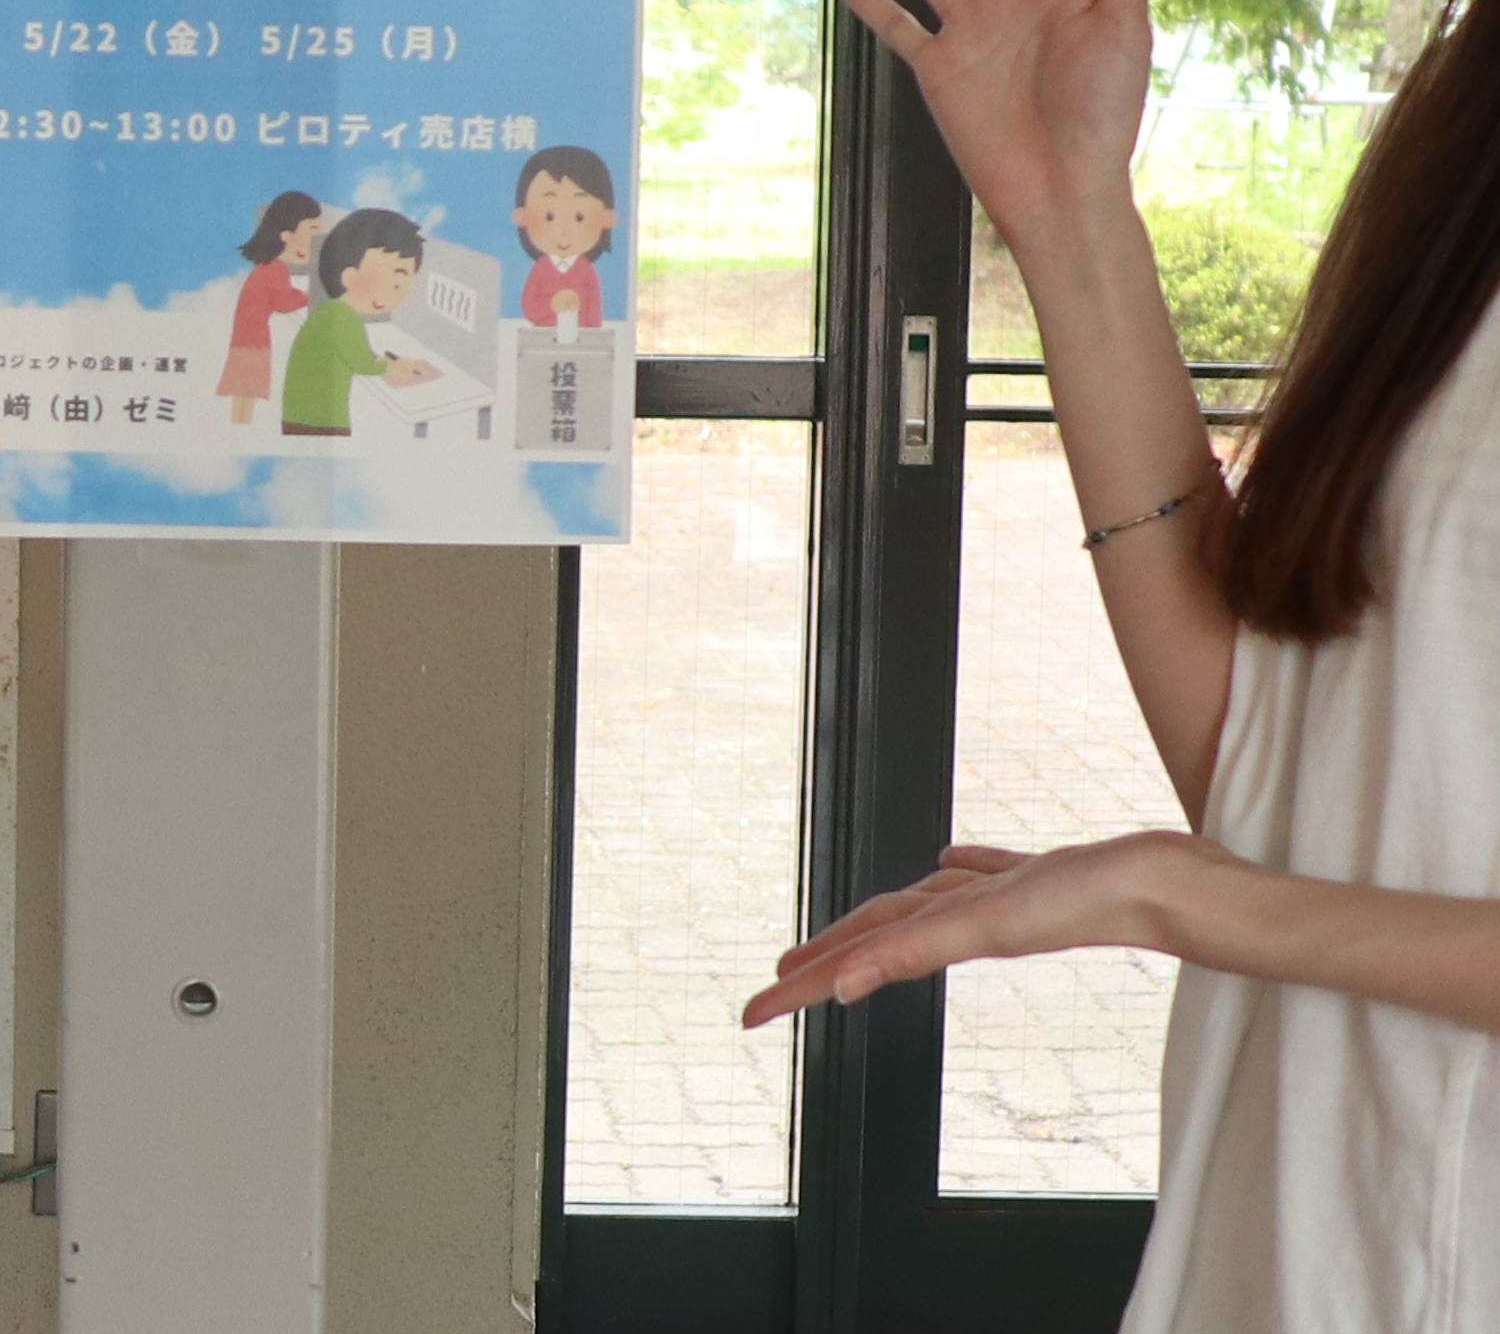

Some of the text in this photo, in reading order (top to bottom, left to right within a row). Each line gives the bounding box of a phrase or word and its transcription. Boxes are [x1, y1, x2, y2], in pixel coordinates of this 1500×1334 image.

[258, 111, 538, 150] ピロティ売店横
[550, 361, 577, 443] 投票箱
